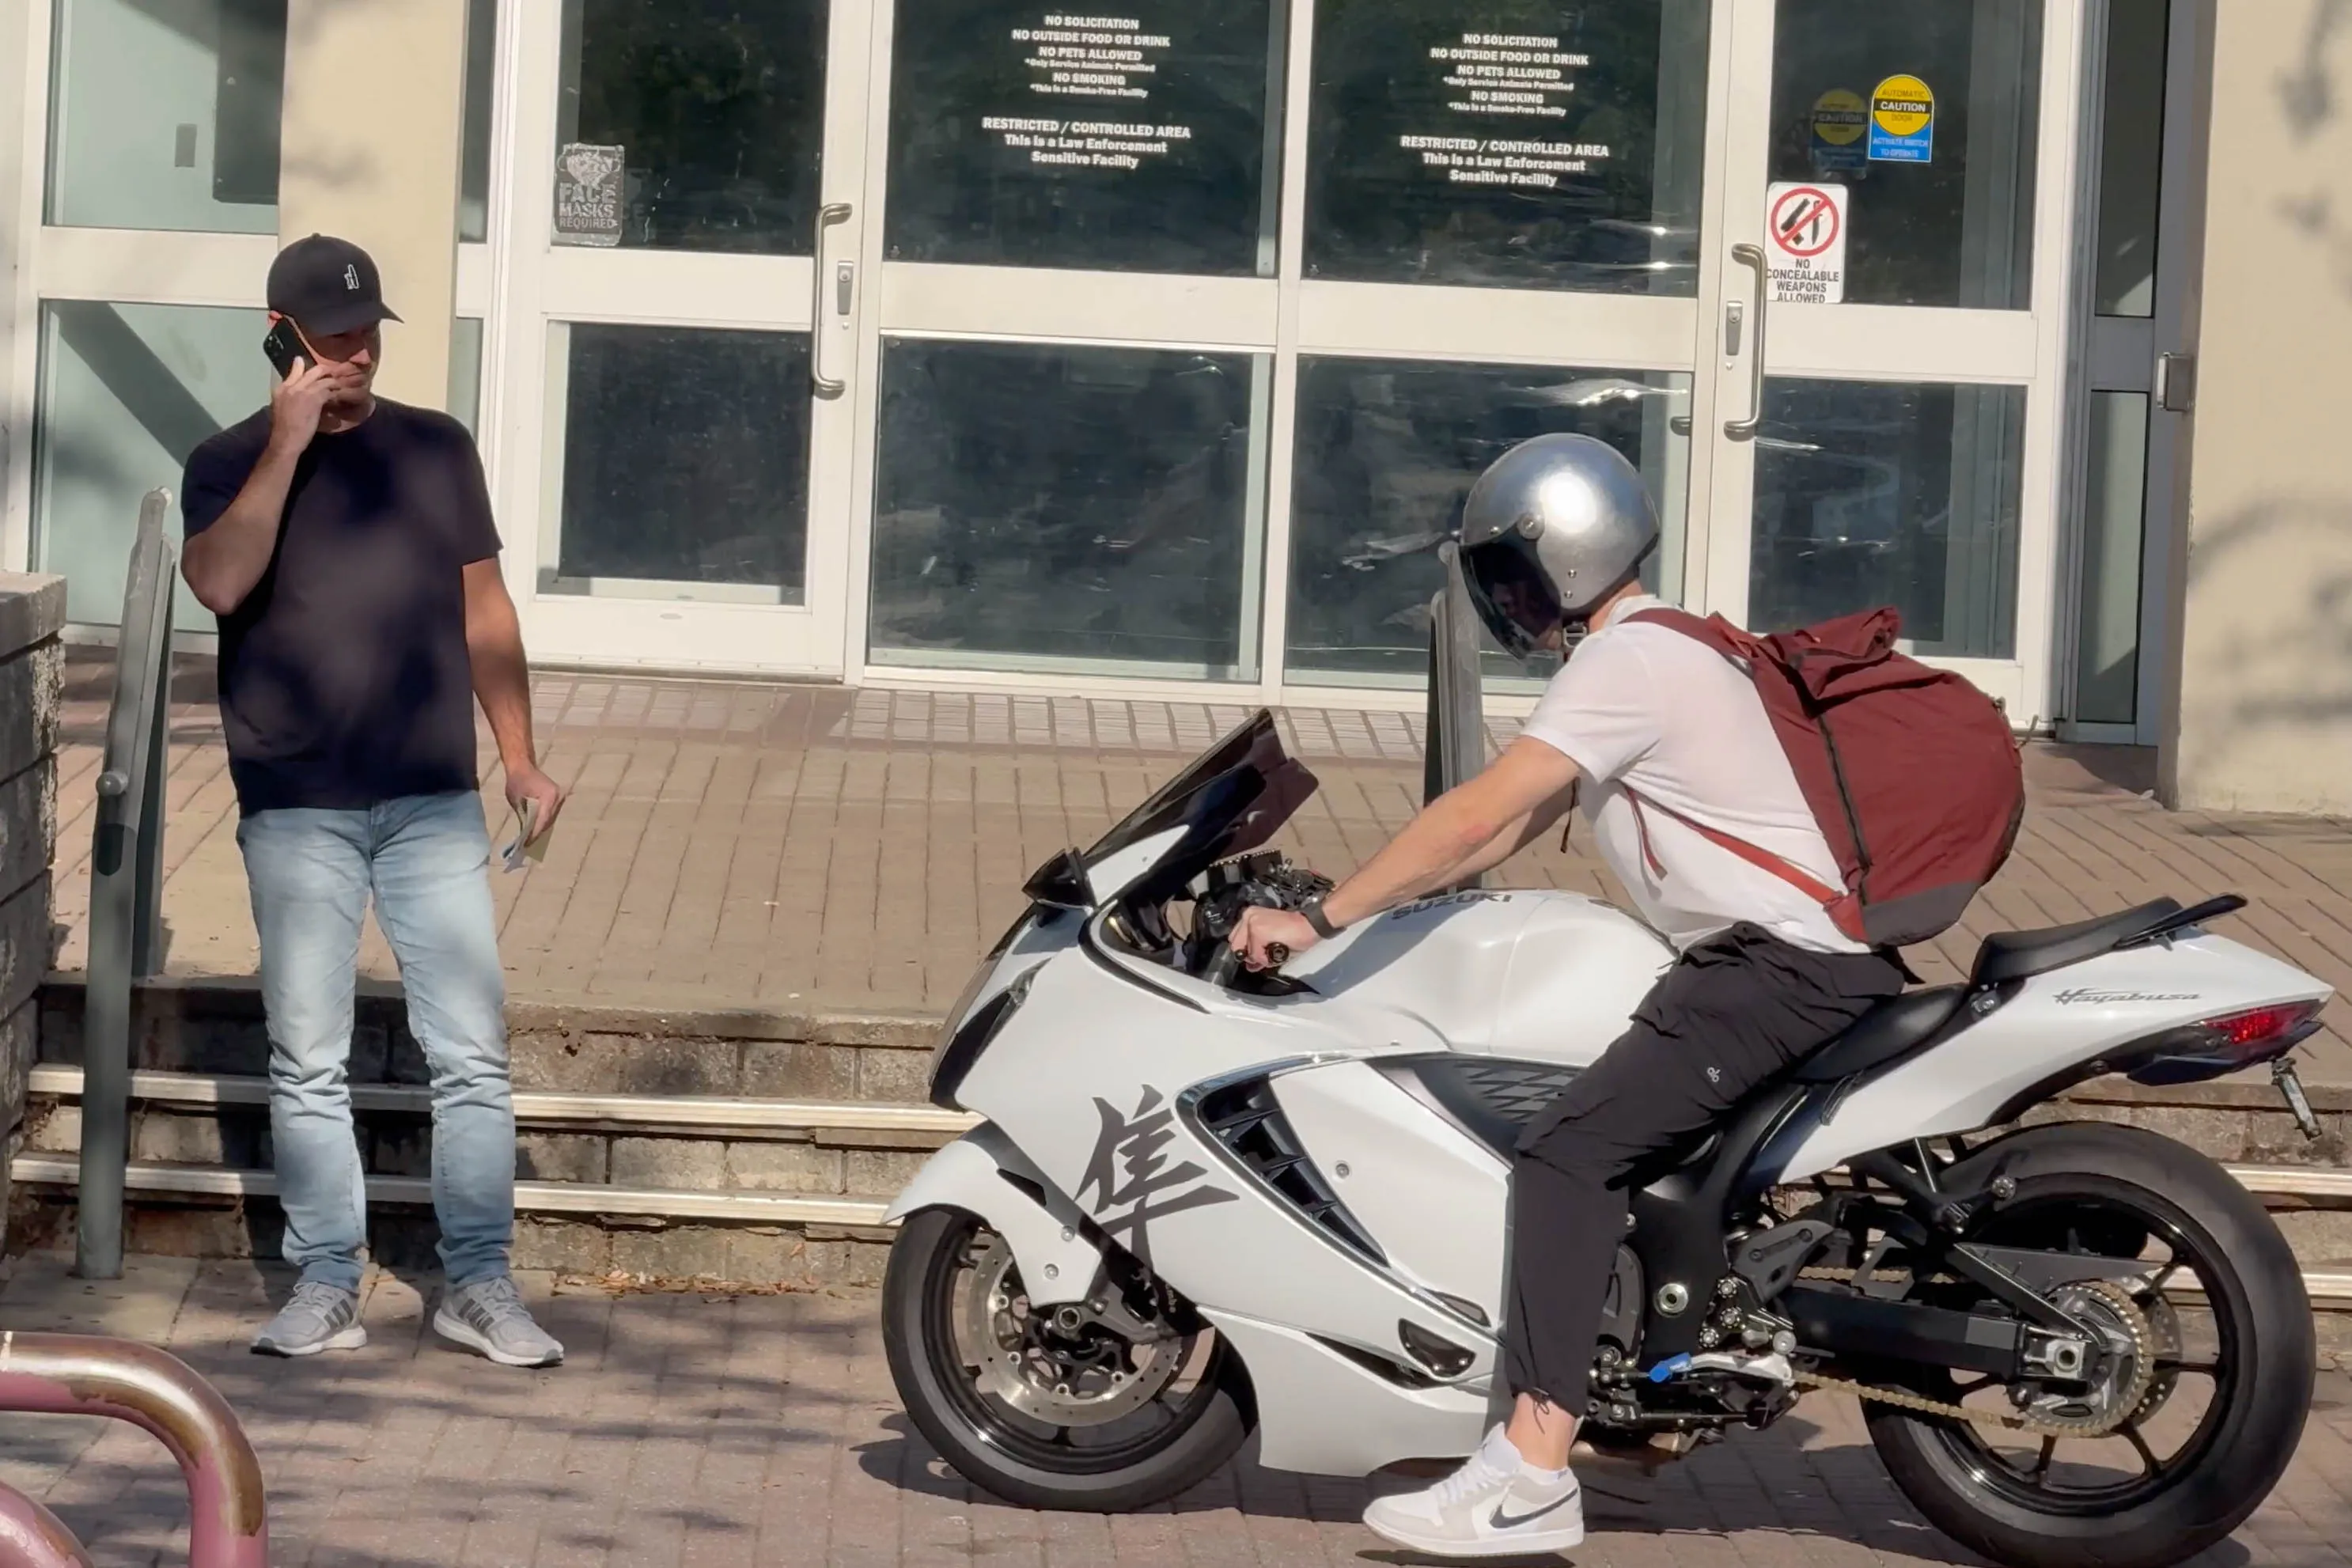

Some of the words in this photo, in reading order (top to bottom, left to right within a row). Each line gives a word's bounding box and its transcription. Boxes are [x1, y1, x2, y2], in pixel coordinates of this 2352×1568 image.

[1044, 15, 1062, 26] NO
[1064, 16, 1139, 30] SOLICITATION
[1012, 29, 1030, 40] NO
[1032, 30, 1080, 43] OUTSIDE
[1081, 32, 1113, 44] FOOD
[1115, 35, 1132, 45] OR
[1133, 36, 1170, 47] DRINK
[1462, 33, 1481, 44] NO
[1483, 34, 1559, 48] SOLICITATION
[1038, 46, 1056, 57] NO
[1058, 47, 1086, 59] PETS
[1088, 49, 1142, 61] ALLOWED
[1430, 47, 1448, 59] NO
[1449, 48, 1498, 61] OUTSIDE
[1500, 51, 1531, 62] FOOD
[1533, 53, 1550, 63] OR
[1552, 54, 1589, 65] DRINK
[1049, 59, 1080, 69] Service
[1081, 61, 1114, 70] Animals
[1115, 63, 1156, 72] Permitted
[1456, 64, 1475, 76] NO
[1476, 66, 1504, 78] PETS
[1506, 67, 1562, 79] ALLOWED
[1052, 72, 1070, 83] NO
[1072, 74, 1126, 85] SMOKING
[1468, 78, 1498, 87] Service
[1499, 79, 1532, 89] Animals
[1533, 81, 1574, 91] Permitted
[1069, 85, 1116, 96] Smoke-Free
[1117, 89, 1149, 99] Facility
[1470, 90, 1489, 102] NO
[1491, 92, 1544, 104] SMOKING
[1882, 89, 1925, 98] AUTOMATIC
[1487, 104, 1535, 115] Smoke-Free
[1536, 107, 1566, 117] Facility
[1880, 100, 1926, 112] CAUTION
[982, 117, 1059, 132] RESTRICTED
[1060, 121, 1070, 134] /
[1071, 122, 1153, 137] CONTROLLED
[1155, 126, 1191, 139] AREA
[1004, 134, 1031, 146] This
[1033, 135, 1045, 147] is
[1047, 138, 1056, 147] a
[1058, 137, 1083, 149] Law
[1085, 138, 1168, 153] Enforcement
[1399, 135, 1478, 150] RESTRICTED
[1478, 139, 1488, 153] /
[1489, 140, 1572, 155] CONTROLLED
[1574, 143, 1609, 157] AREA
[1031, 151, 1089, 165] Sensitive
[1092, 154, 1139, 169] Facility
[1422, 152, 1449, 165] This
[1451, 153, 1464, 165] is
[1464, 156, 1475, 165] a
[1477, 155, 1502, 168] Law
[1504, 156, 1586, 172] Enforcement
[1449, 169, 1508, 184] Sensitive
[1510, 172, 1558, 187] Facility
[559, 183, 616, 204] FACE
[559, 203, 615, 218] MASKS
[559, 216, 615, 229] REQUIRED
[1795, 259, 1810, 269] NO
[1766, 269, 1839, 282] CONCEALABLE
[1777, 281, 1827, 293] WEAPONS
[1777, 292, 1826, 304] ALLOWED
[1392, 893, 1513, 920] SUZUKI
[2052, 987, 2202, 1006] Hayabusa
